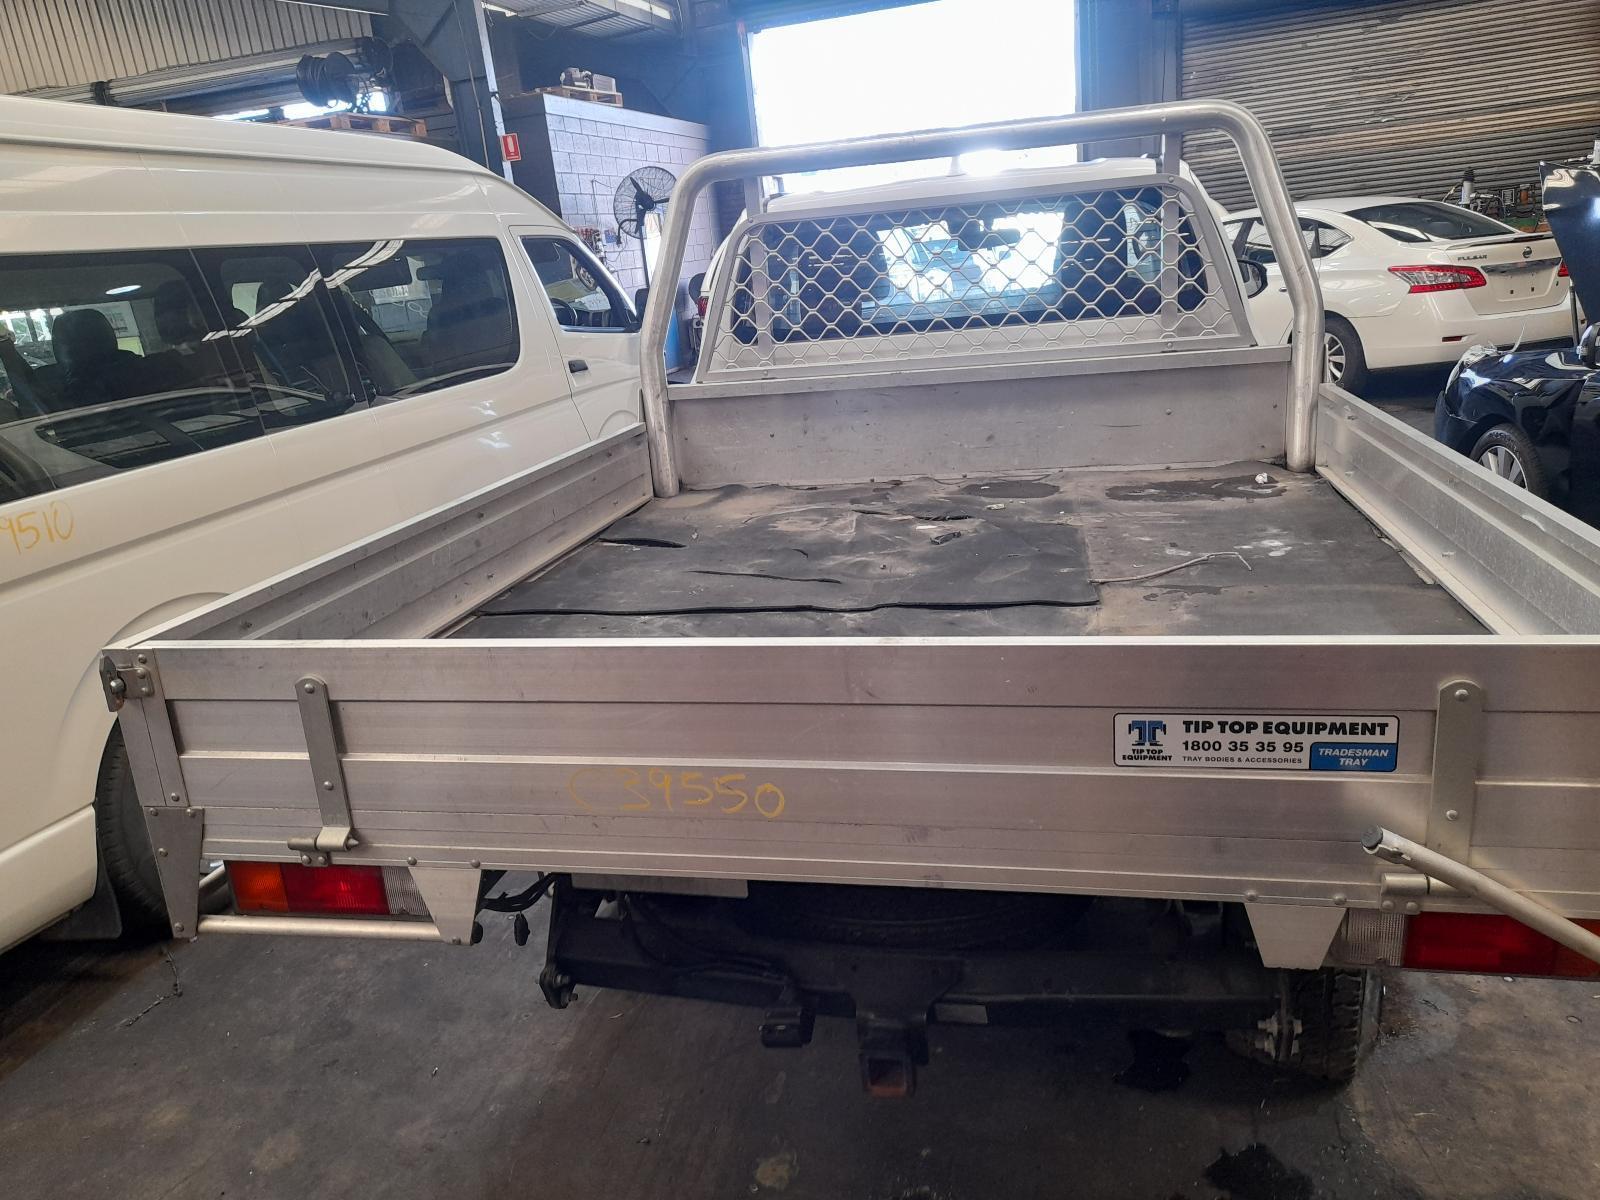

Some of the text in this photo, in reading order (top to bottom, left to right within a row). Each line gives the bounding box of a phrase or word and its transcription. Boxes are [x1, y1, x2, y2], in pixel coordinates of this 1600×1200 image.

[1182, 720, 1389, 736] TIP TOP EQUIPMENT
[1182, 740, 1304, 753] 1800 35 35 95
[1318, 748, 1389, 757] TRADESMAN
[1339, 757, 1368, 766] TRAY
